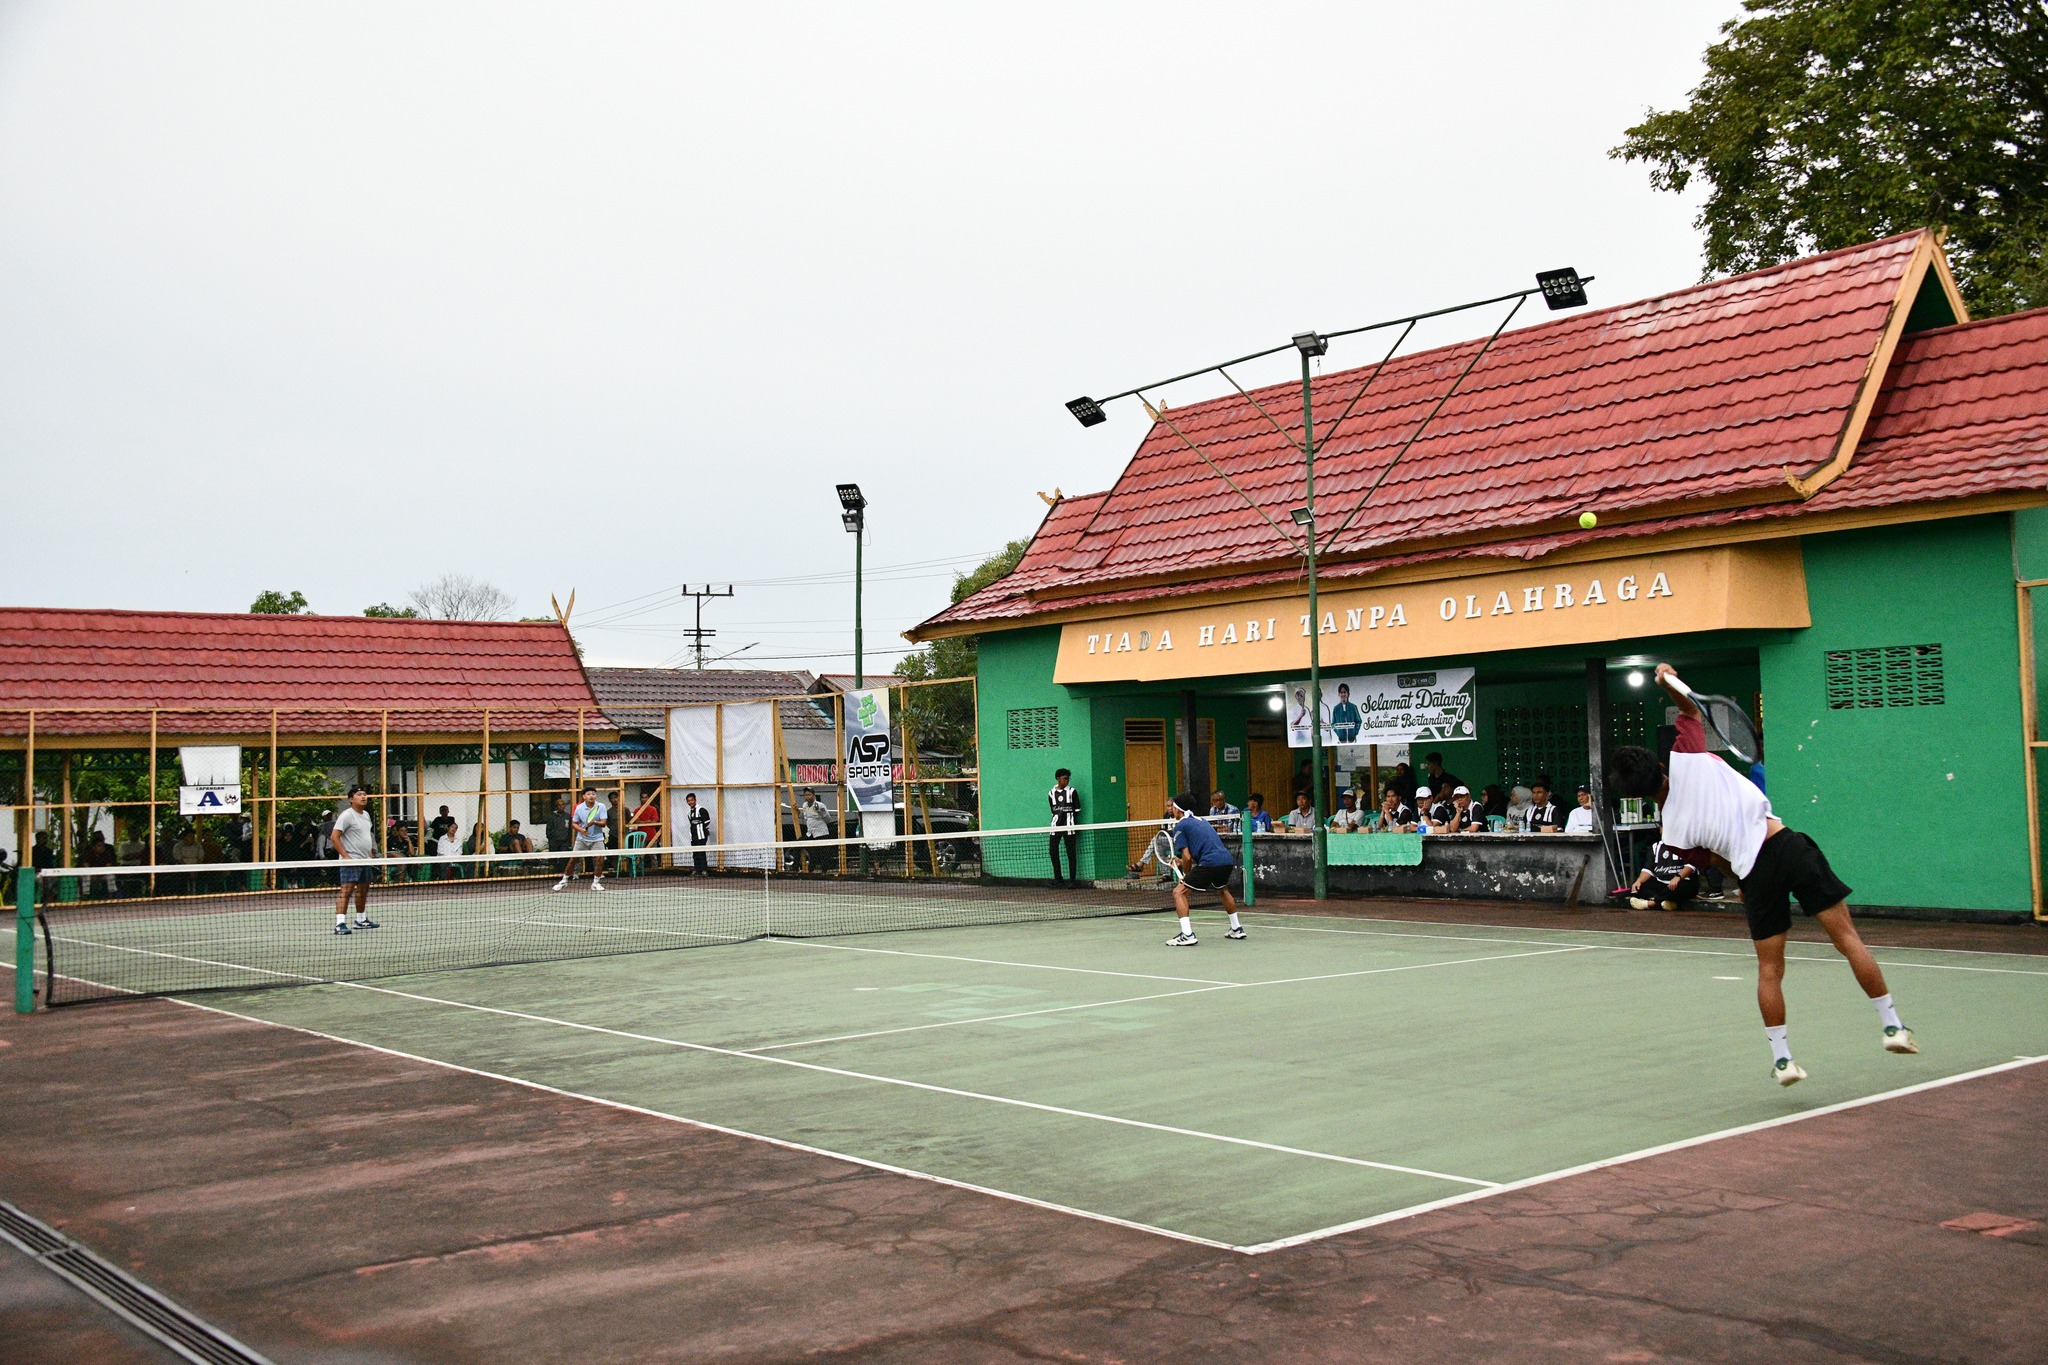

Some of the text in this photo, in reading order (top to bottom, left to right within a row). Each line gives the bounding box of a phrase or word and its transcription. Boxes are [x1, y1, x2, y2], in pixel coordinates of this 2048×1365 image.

[1087, 571, 1673, 655] TIADA HARI TANPA OLAHRAGA
[1360, 688, 1470, 721] Selamat Datang
[1363, 712, 1455, 735] Selamat Bertanding
[848, 734, 890, 764] ASP
[796, 764, 829, 783] PONDOK
[848, 765, 890, 779] SPORTS
[197, 791, 223, 807] A
